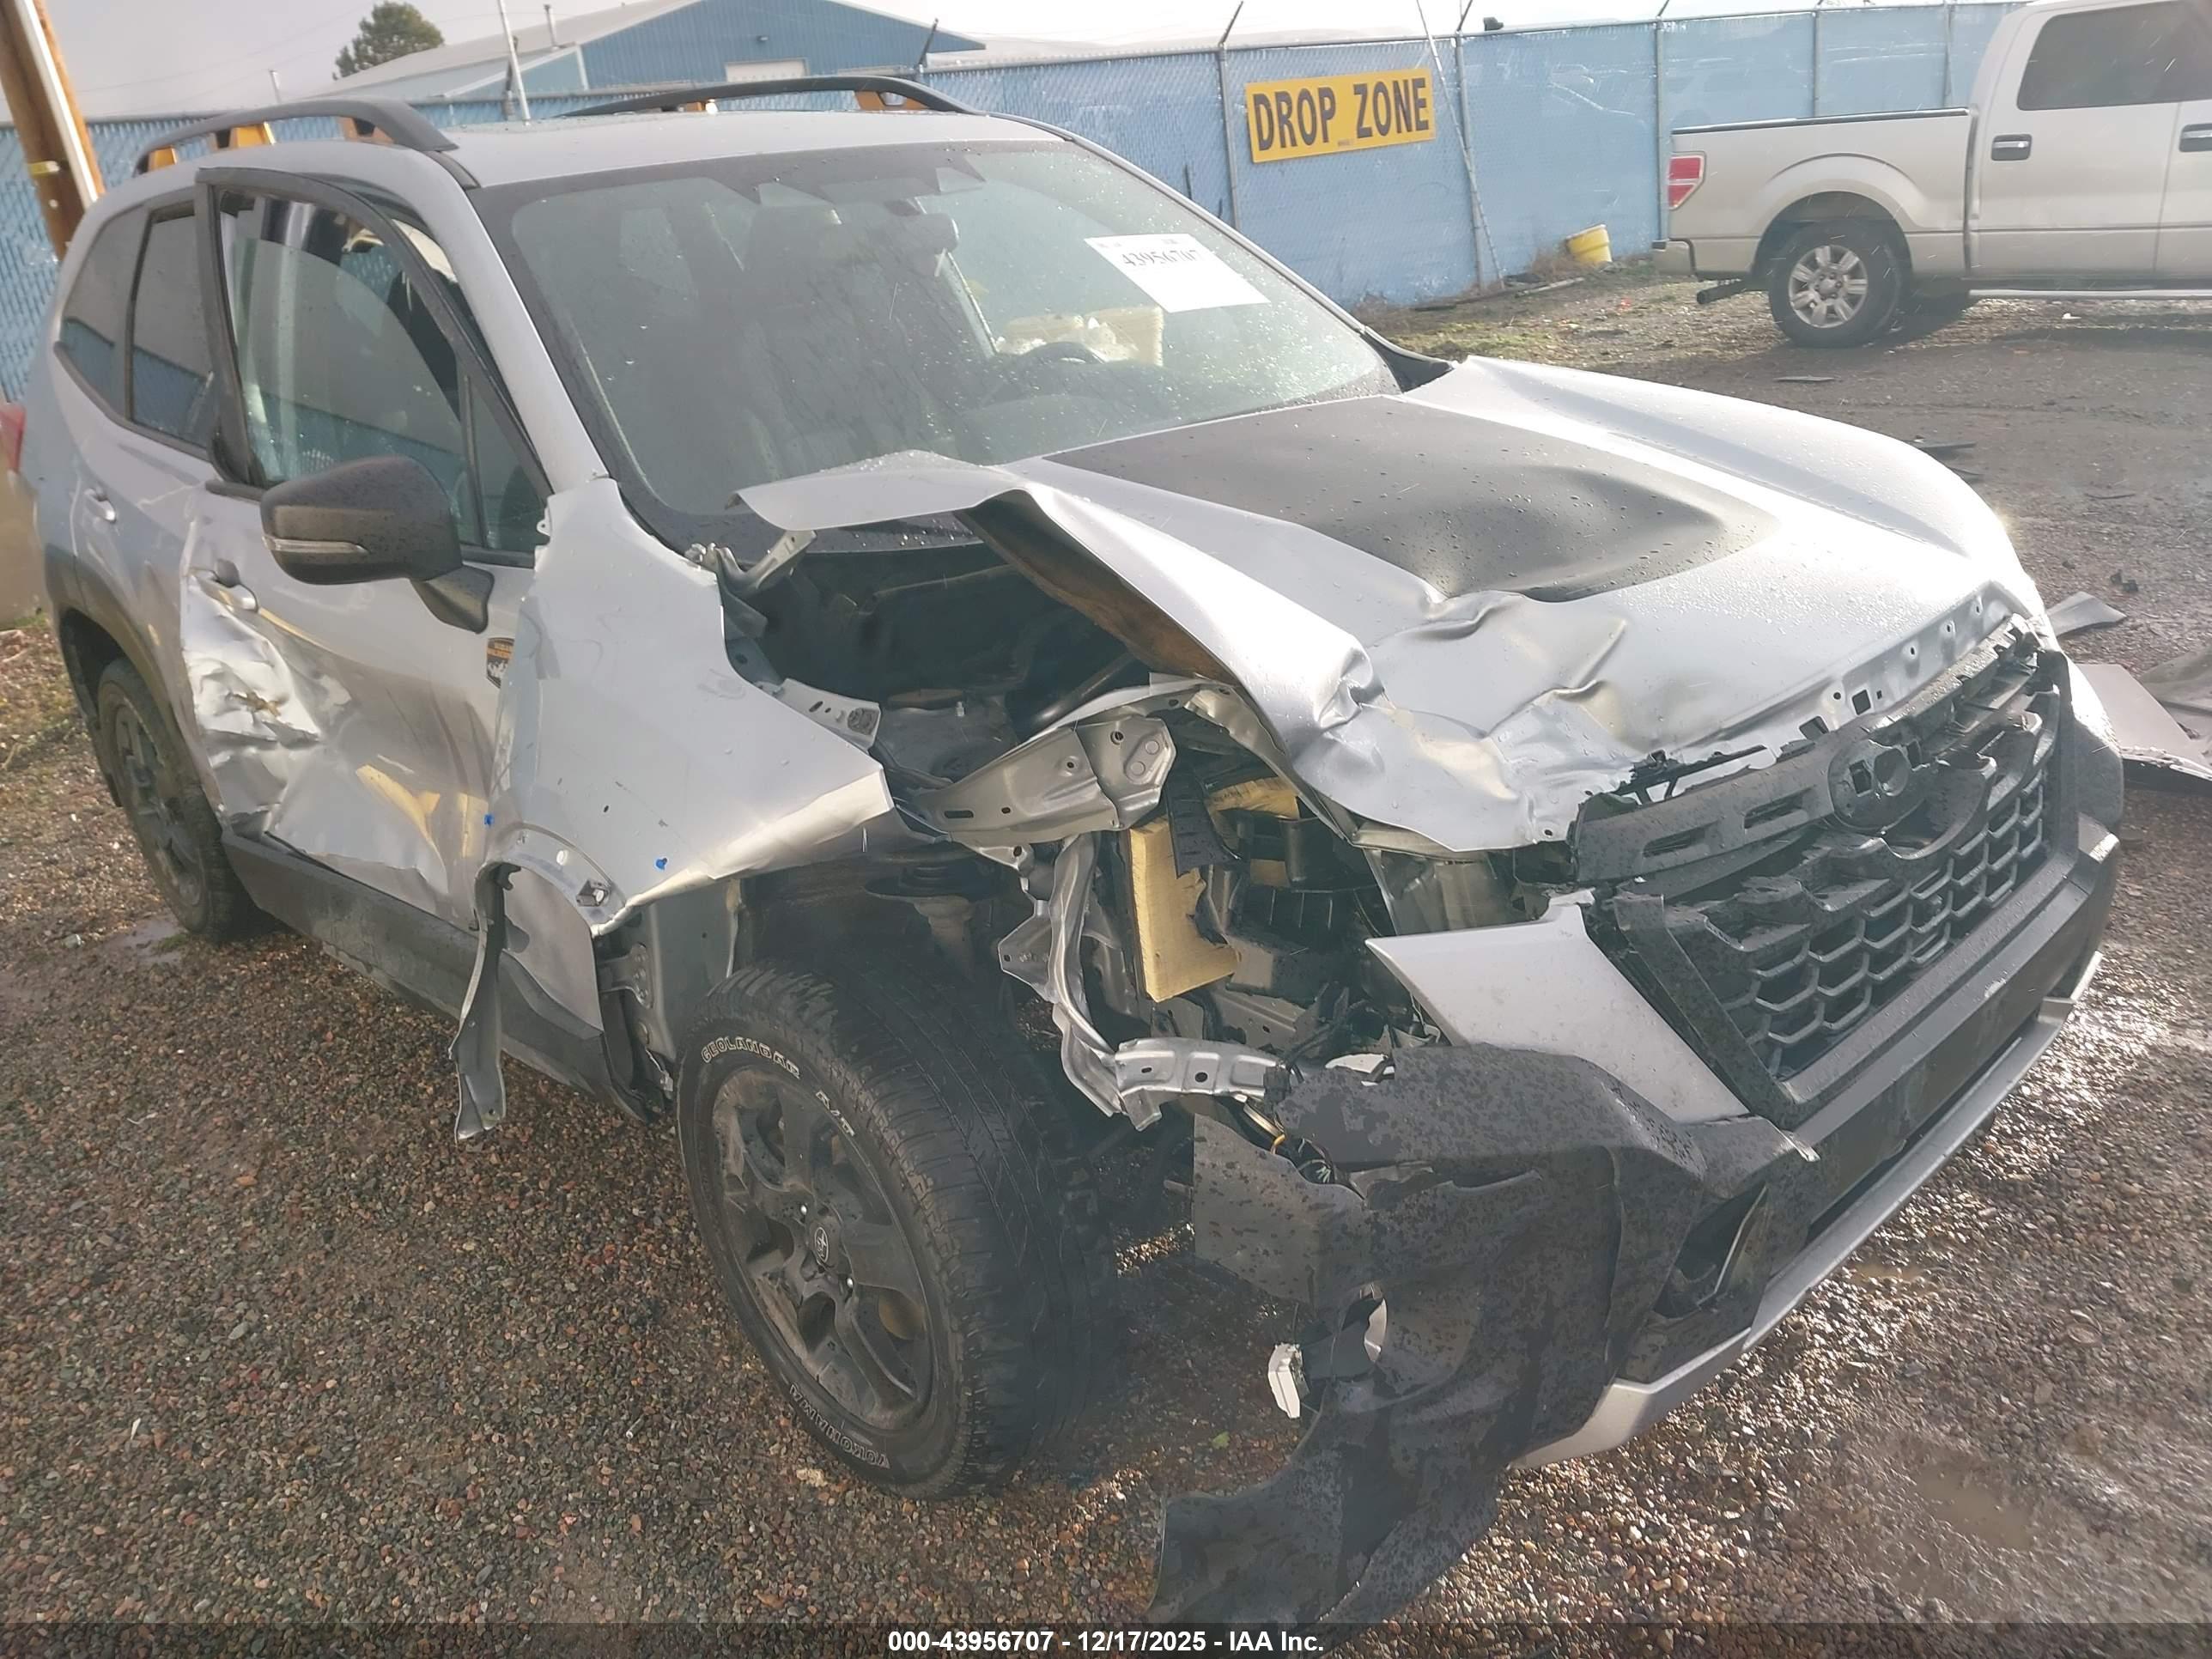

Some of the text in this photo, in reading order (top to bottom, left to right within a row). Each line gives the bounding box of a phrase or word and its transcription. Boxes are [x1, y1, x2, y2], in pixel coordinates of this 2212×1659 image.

[1253, 77, 1430, 151] DROP ZONE
[701, 1036, 801, 1079] GEOLANDAR
[789, 1382, 891, 1470] YOKOHAMA
